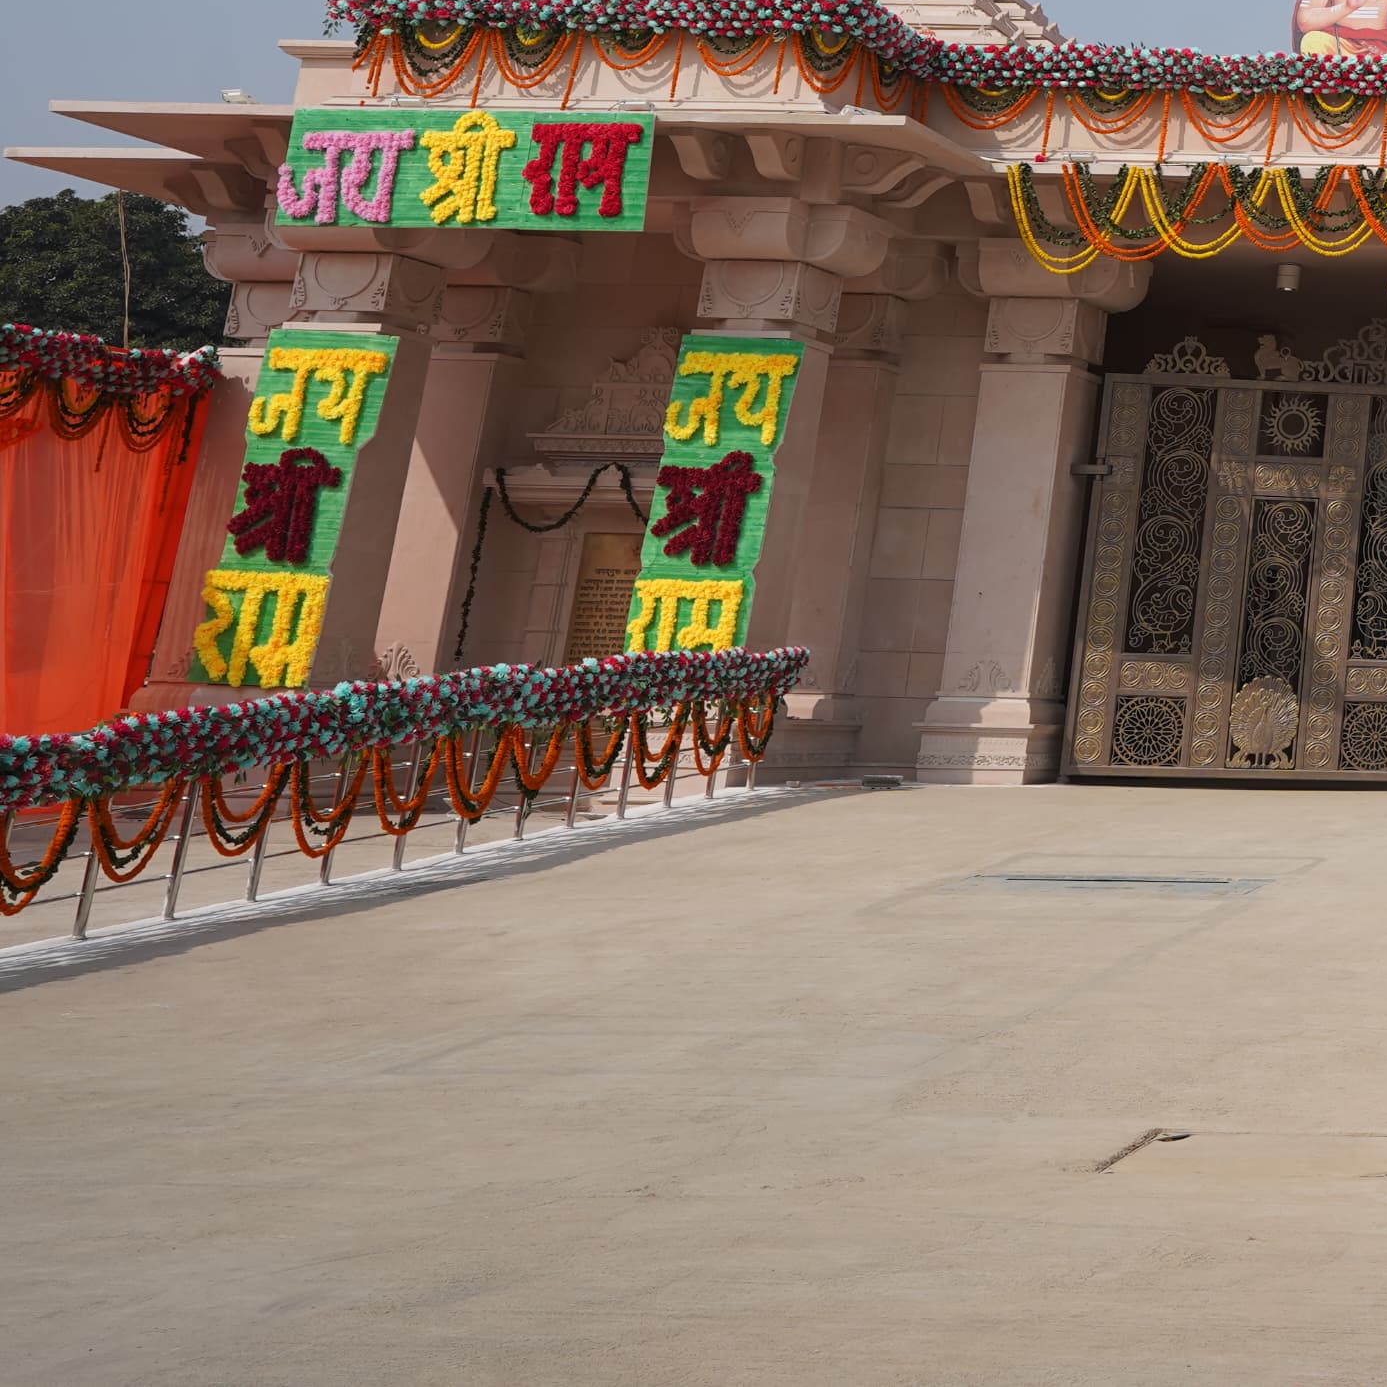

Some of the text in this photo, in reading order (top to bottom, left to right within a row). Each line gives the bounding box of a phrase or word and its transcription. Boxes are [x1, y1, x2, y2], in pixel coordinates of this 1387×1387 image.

[276, 110, 643, 224] जय श्री राम
[248, 346, 389, 446] जय
[664, 351, 799, 447] जय
[226, 446, 343, 566] श्री
[650, 449, 764, 567] श्री
[194, 568, 331, 689] राम
